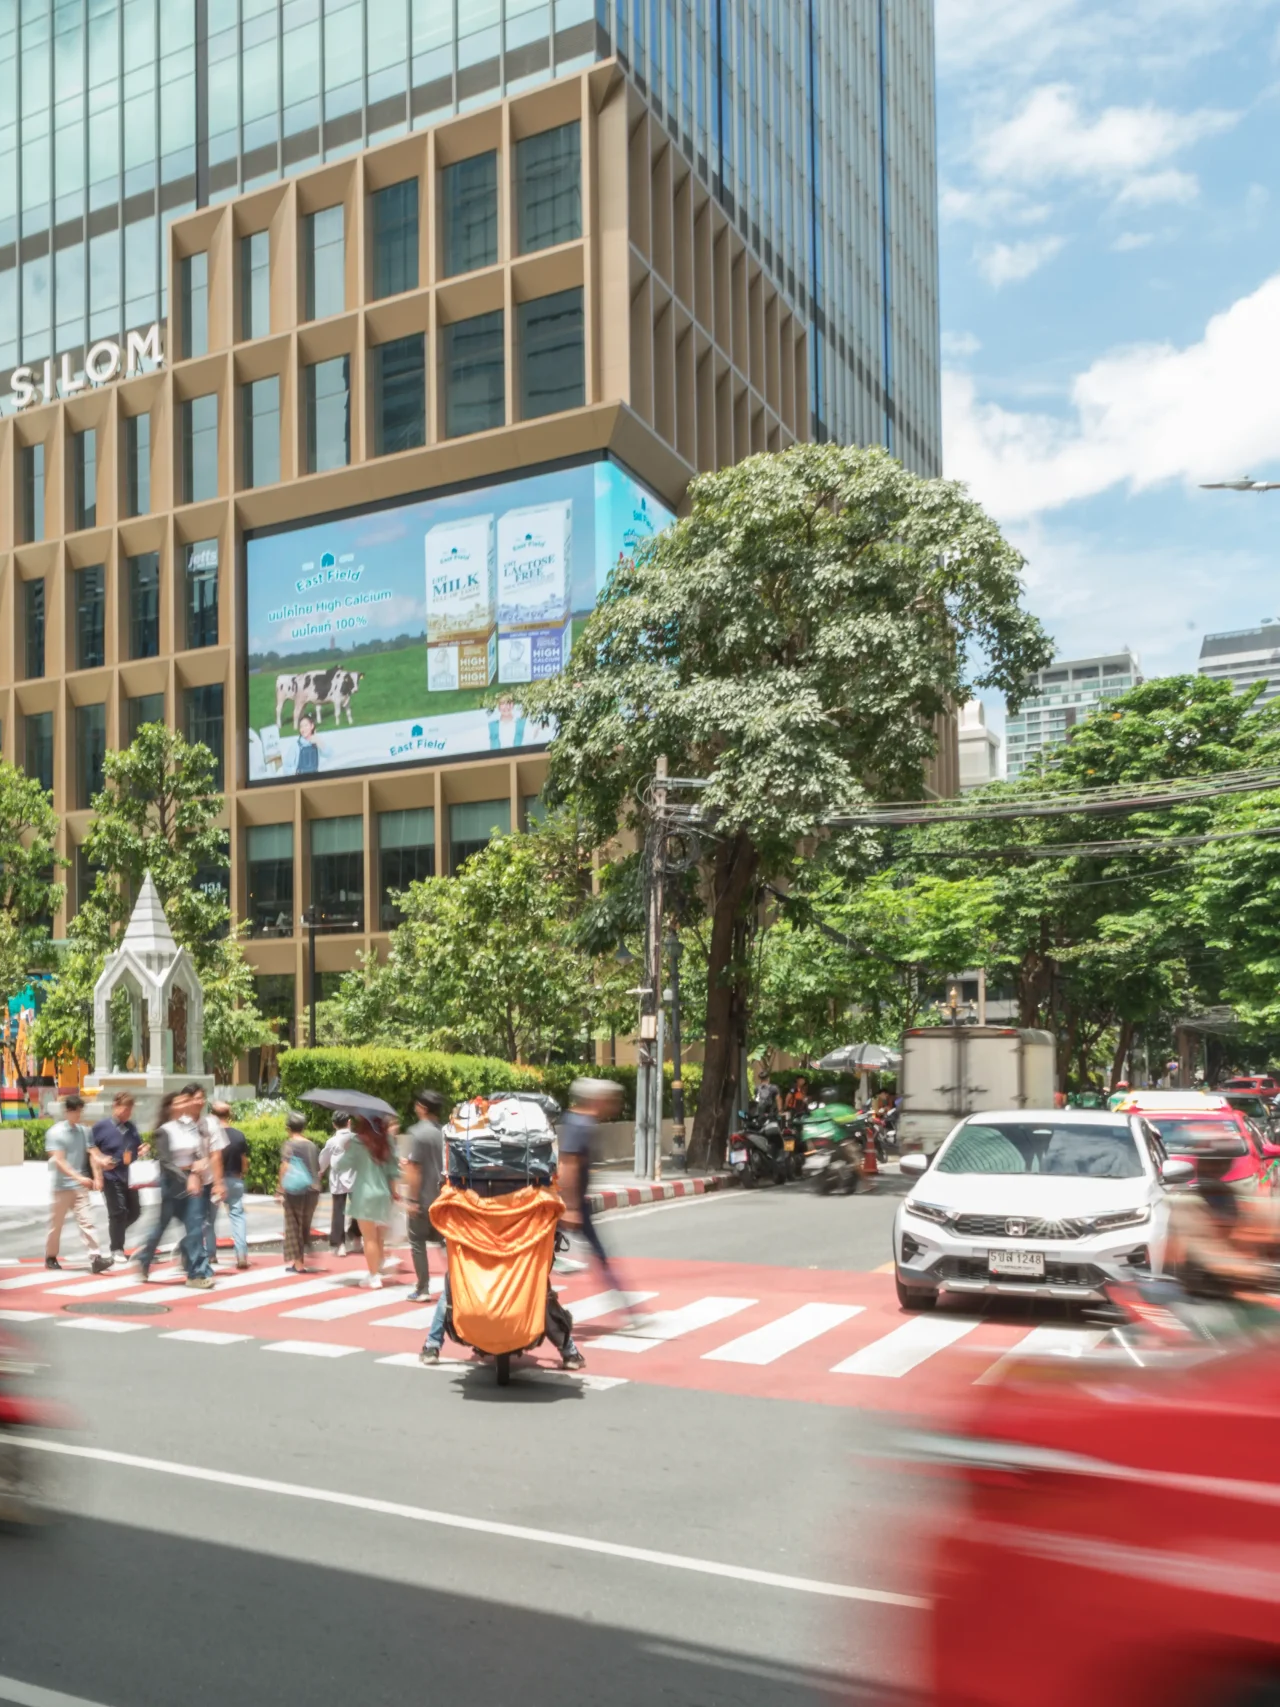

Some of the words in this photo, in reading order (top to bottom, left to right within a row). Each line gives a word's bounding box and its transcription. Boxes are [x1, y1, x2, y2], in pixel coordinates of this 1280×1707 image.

[10, 323, 165, 408] SILOM
[503, 554, 556, 578] LACTOSE
[295, 573, 323, 593] East
[327, 569, 362, 583] Field
[515, 567, 542, 583] FREE
[433, 571, 479, 597] MILK
[316, 598, 342, 612] High
[344, 589, 392, 607] Calcium
[335, 616, 367, 630] 100%
[460, 656, 486, 666] HIGH
[533, 648, 560, 658] HIGH
[460, 671, 486, 682] HIGH
[533, 663, 560, 674] HIGH
[389, 741, 413, 756] East
[417, 739, 446, 751] Field
[1017, 1253, 1041, 1264] 1248
